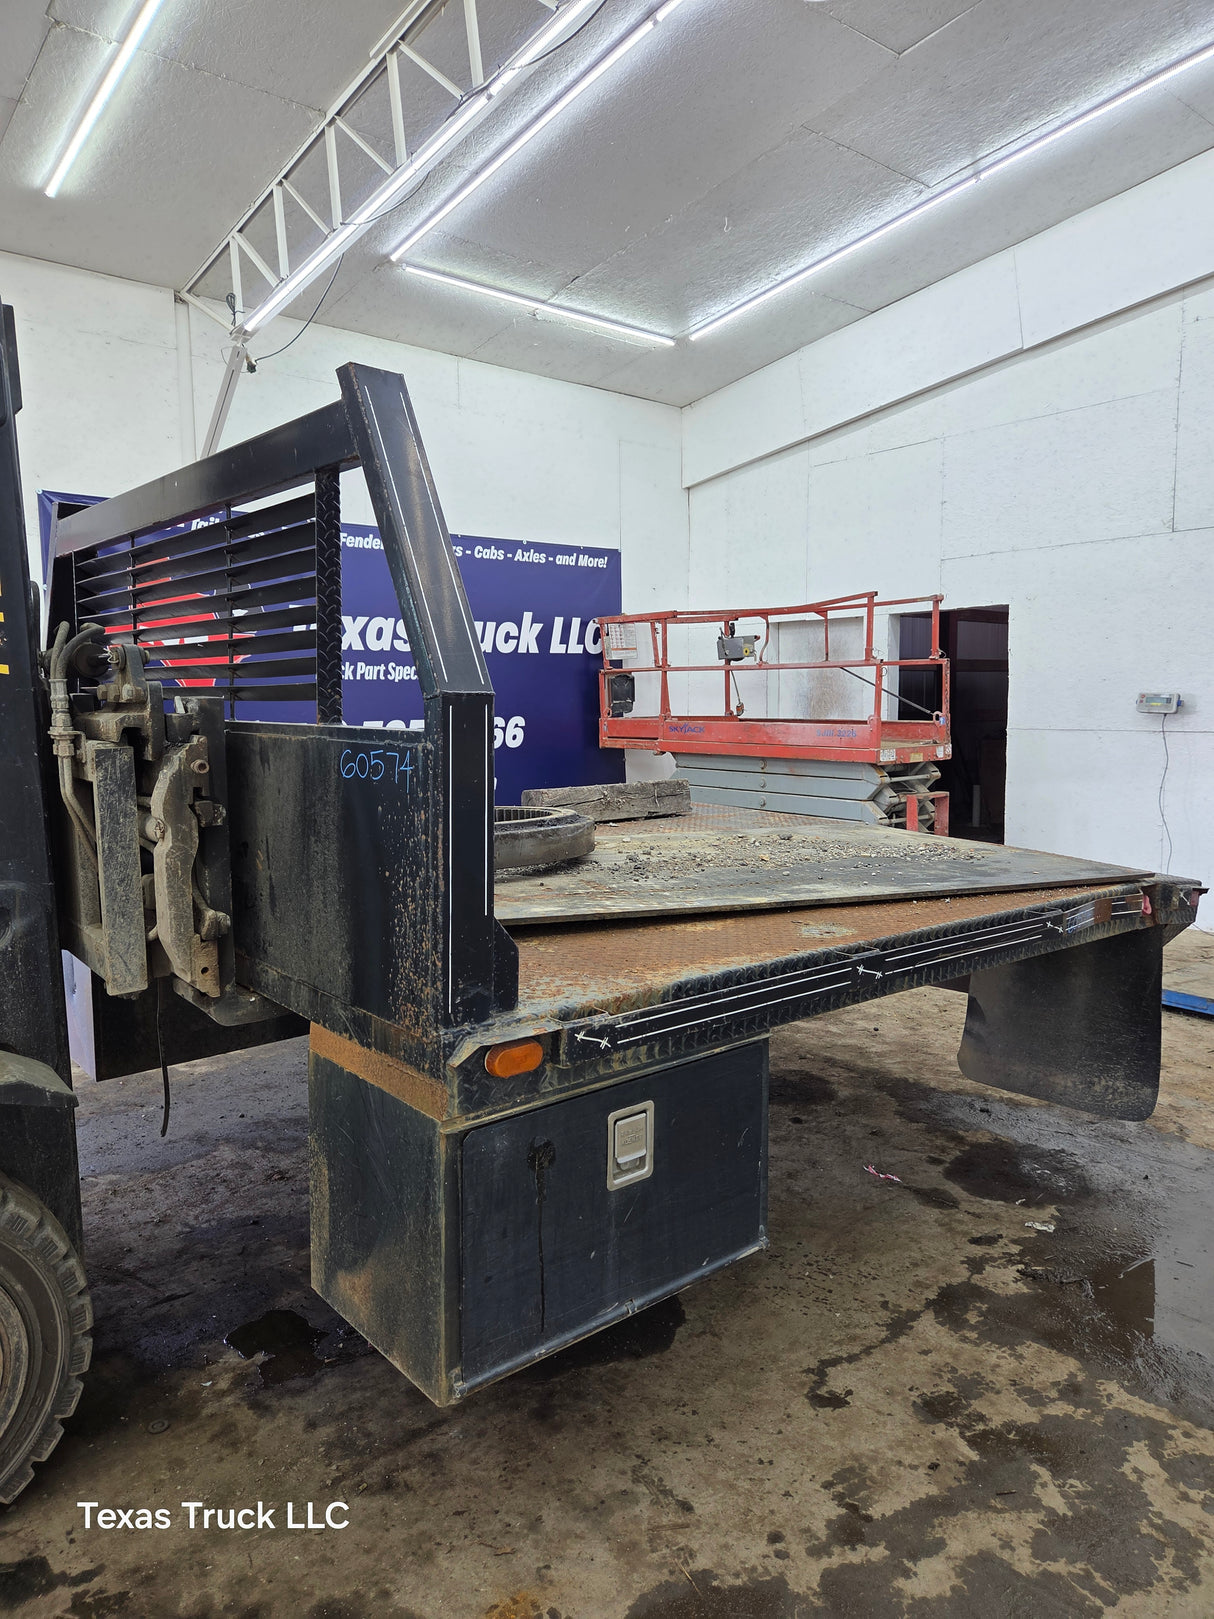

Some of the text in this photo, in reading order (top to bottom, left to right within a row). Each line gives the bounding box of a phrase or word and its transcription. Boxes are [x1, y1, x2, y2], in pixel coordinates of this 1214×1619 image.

[474, 545, 505, 560] Cabs
[514, 549, 546, 564] Axles
[556, 553, 576, 567] and
[578, 554, 608, 569] More!
[550, 616, 602, 655] LLC
[356, 661, 386, 680] Part
[668, 722, 705, 734] SKYJACK
[340, 749, 414, 794] 60574
